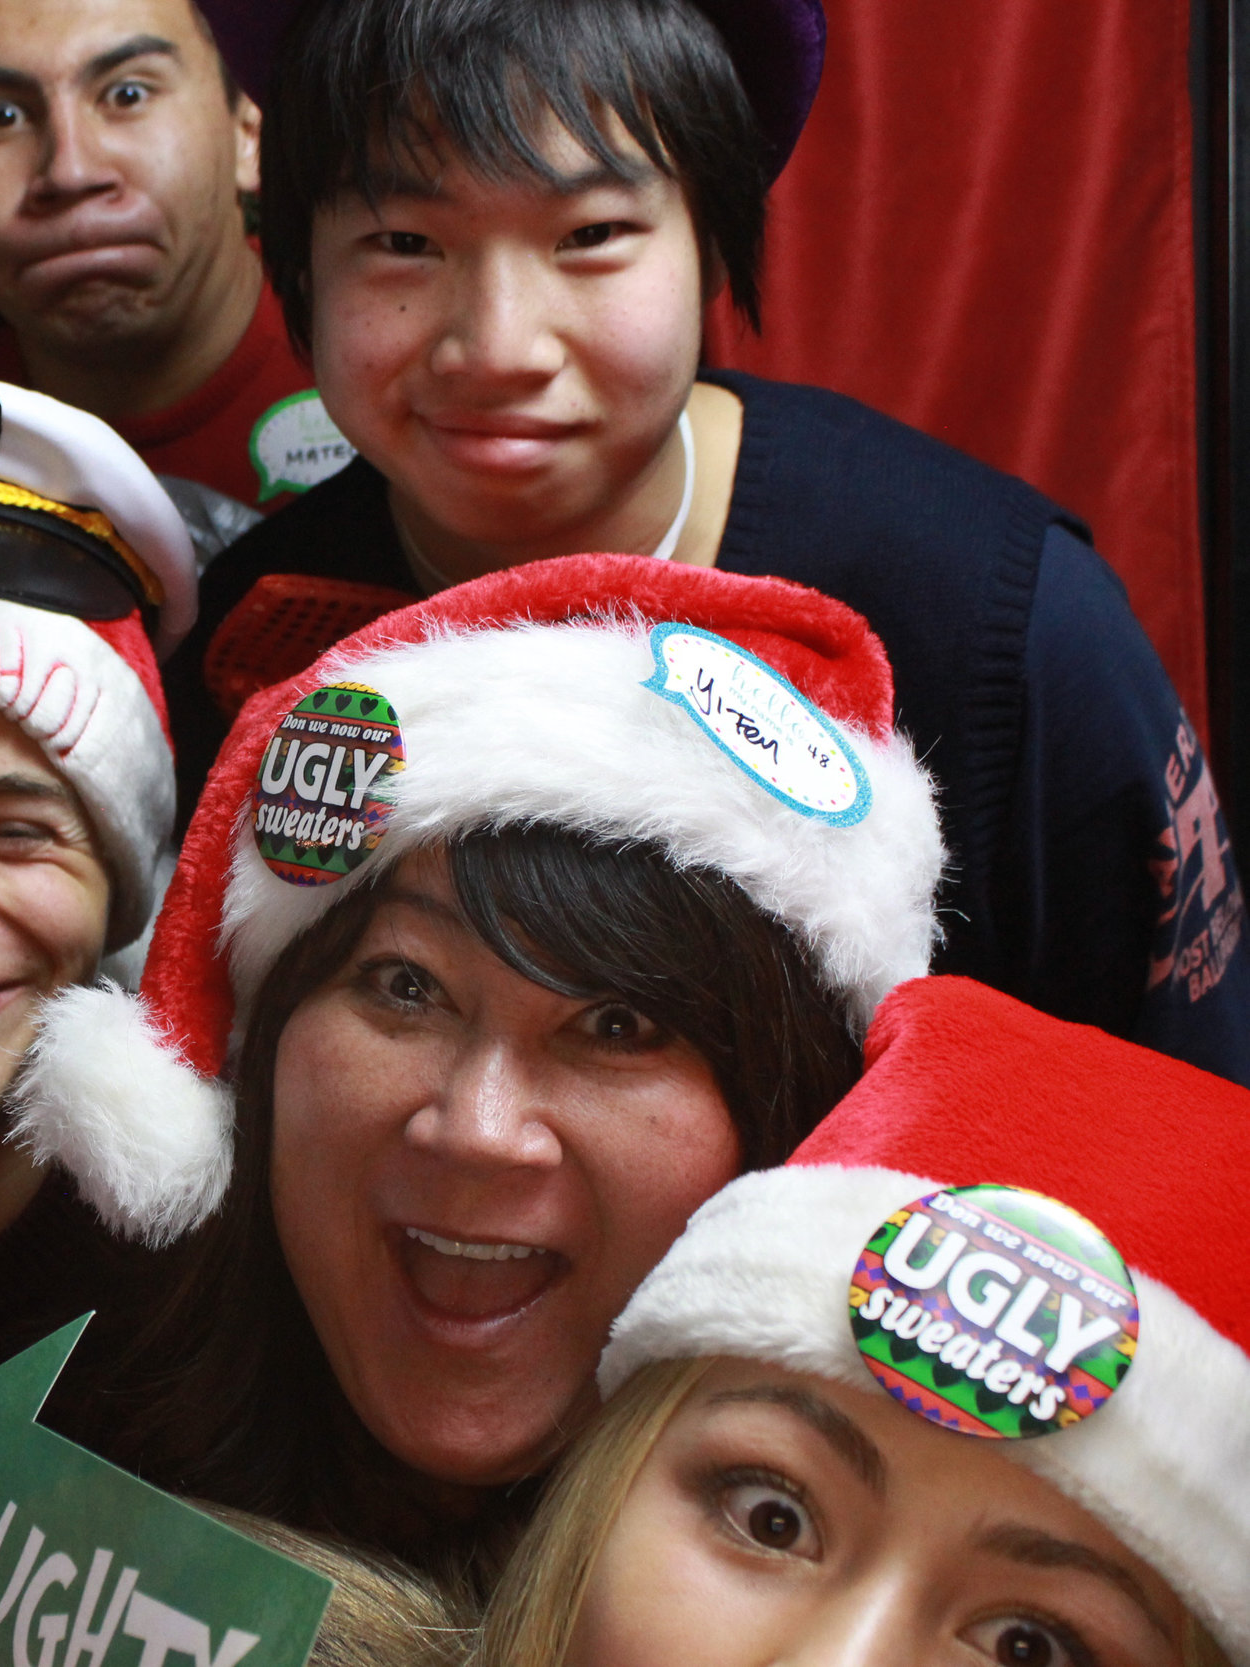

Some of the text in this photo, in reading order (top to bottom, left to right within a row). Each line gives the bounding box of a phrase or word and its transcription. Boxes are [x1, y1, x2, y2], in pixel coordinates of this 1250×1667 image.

[282, 714, 392, 743] Don we now our
[751, 704, 783, 736] name
[261, 736, 389, 810] UGLY
[807, 744, 830, 768] 48
[255, 803, 365, 851] sweaters
[929, 1192, 1128, 1308] Don we now our
[883, 1211, 1121, 1373] UGLY
[858, 1287, 1066, 1420] sweaters
